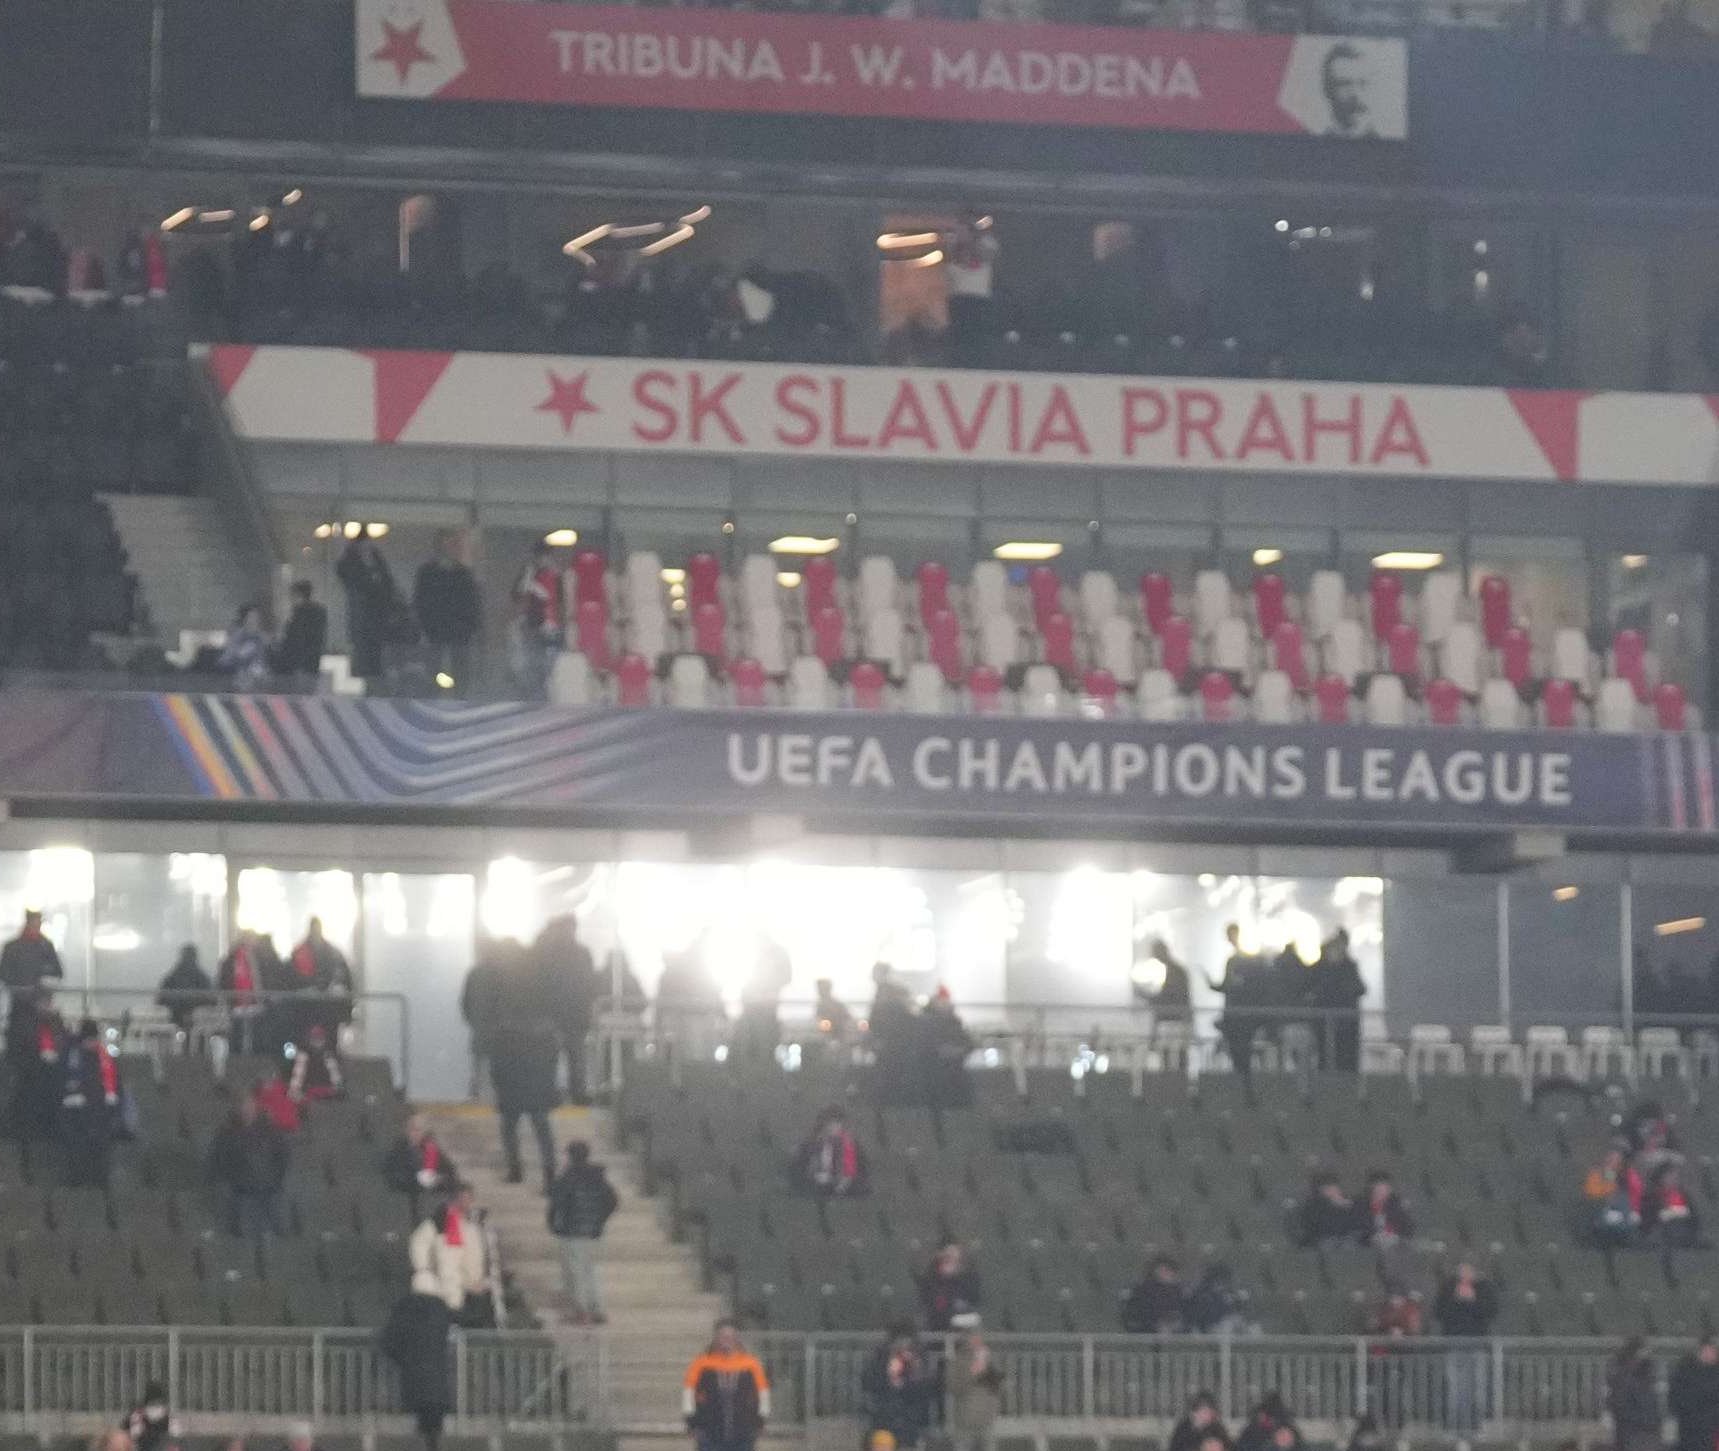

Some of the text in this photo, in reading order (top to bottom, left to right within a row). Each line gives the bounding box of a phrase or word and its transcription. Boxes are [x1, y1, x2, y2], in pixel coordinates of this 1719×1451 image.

[550, 29, 1201, 100] TRIBUNA J. W. MADDENA
[631, 369, 1431, 468] SK SLAVIA PRAHA
[726, 733, 1574, 804] UEFA CHAMPIONS LEAGUE
